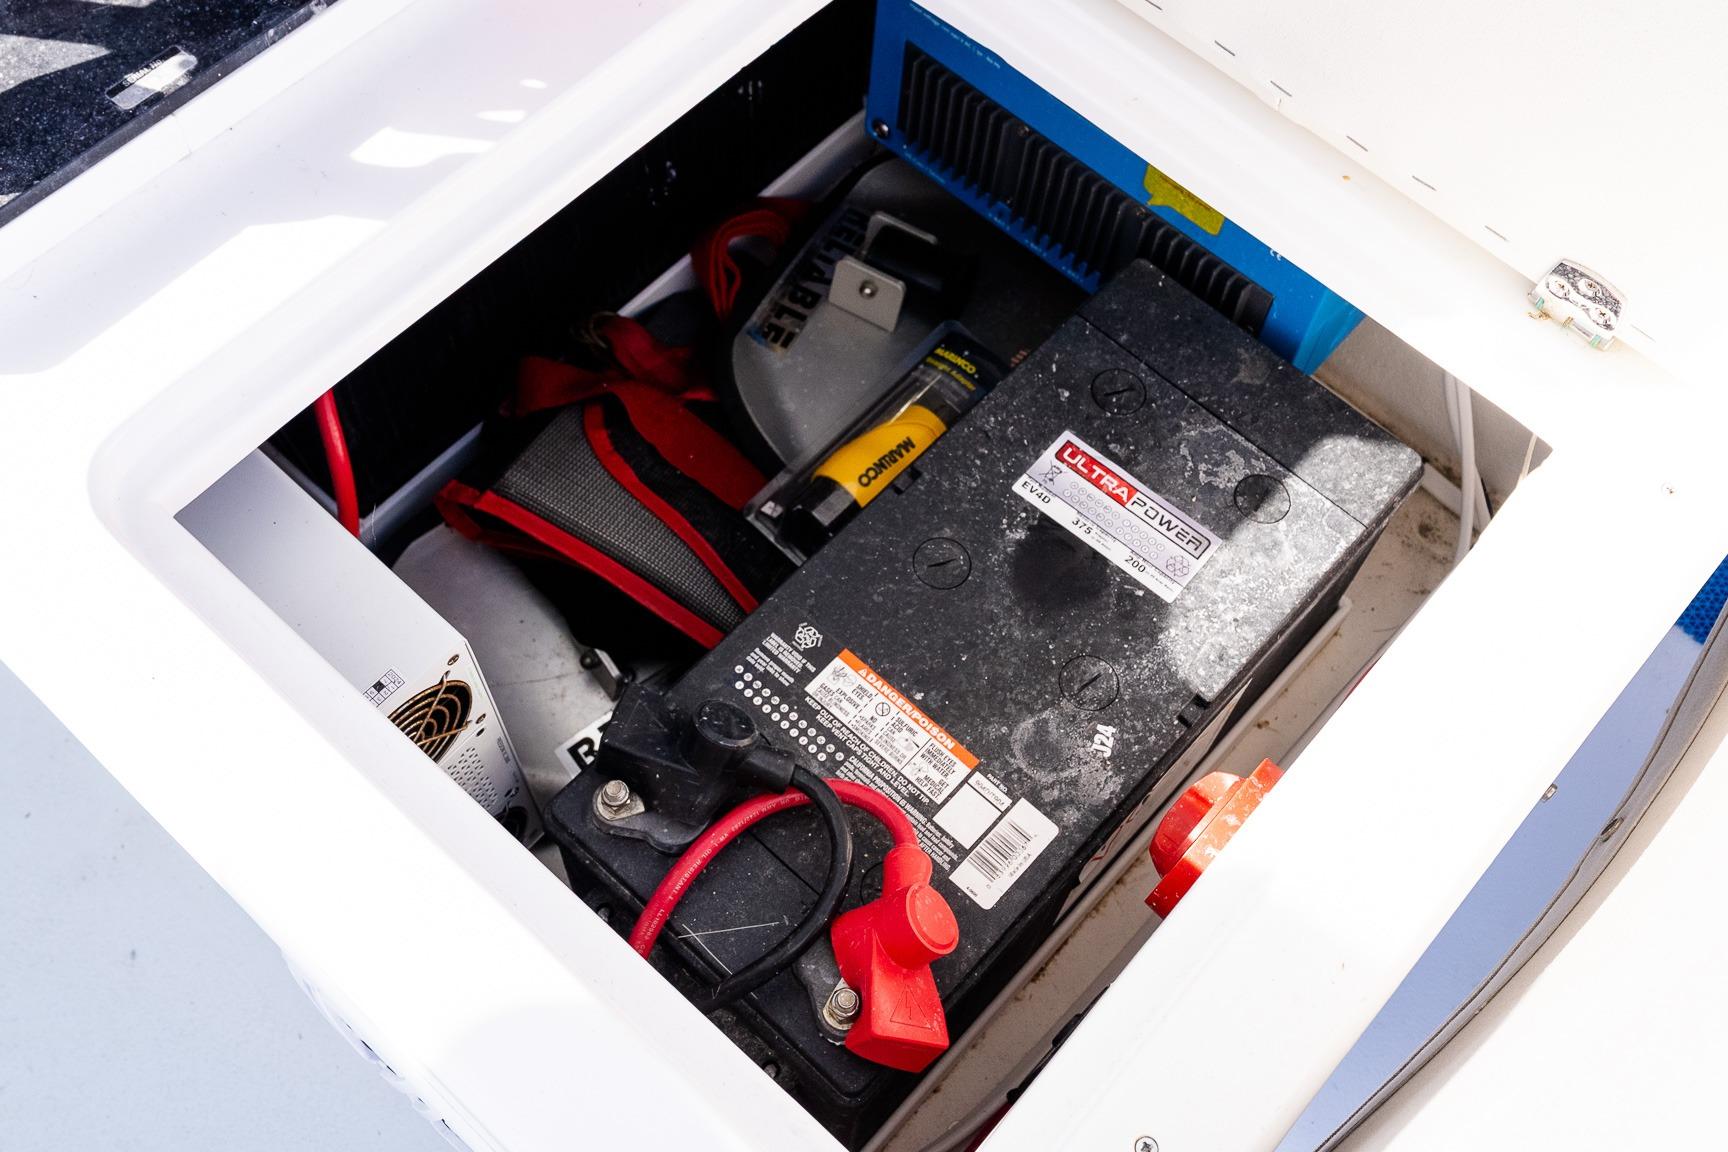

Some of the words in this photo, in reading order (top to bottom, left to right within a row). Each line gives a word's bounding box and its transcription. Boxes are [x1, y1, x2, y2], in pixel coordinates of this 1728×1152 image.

[932, 343, 978, 376] MARINCO
[855, 435, 916, 490] MARINCO
[1021, 480, 1051, 504] EV4D
[1063, 447, 1131, 503] ULTRA
[1131, 497, 1203, 553] POWER
[1071, 517, 1093, 536] 375
[1124, 554, 1146, 574] 200
[819, 682, 835, 696] GASES
[835, 687, 860, 709] EXPLOSIVE
[855, 684, 872, 698] SHIELD
[864, 672, 956, 750] DANGER/POISON
[868, 715, 877, 723] NO
[886, 726, 896, 735] CAN
[890, 721, 903, 733] ACID
[894, 716, 918, 737] SULFURIC
[803, 696, 821, 711] KEEP
[819, 709, 834, 722] OUT
[832, 720, 842, 728] OF
[839, 726, 861, 745] REACH
[859, 743, 870, 752] OF
[896, 775, 908, 785] DO
[905, 783, 920, 796] NOT
[815, 714, 833, 730] KEEP
[830, 727, 847, 742] VENT
[844, 739, 863, 755] CAPS
[860, 752, 878, 768] TIGHT
[875, 765, 891, 780] AND
[1089, 723, 1116, 757] J24
[919, 752, 933, 765] WITH
[923, 747, 955, 775] IMMEDIATELY
[928, 743, 945, 757] FLUSH
[942, 754, 956, 767] EYES
[848, 755, 875, 778] CALIFORNIA
[871, 775, 902, 802] PROPOSITION
[914, 776, 928, 789] HELP
[922, 774, 945, 794] MEDICAL
[937, 778, 949, 789] GET
[986, 772, 1000, 785] PART
